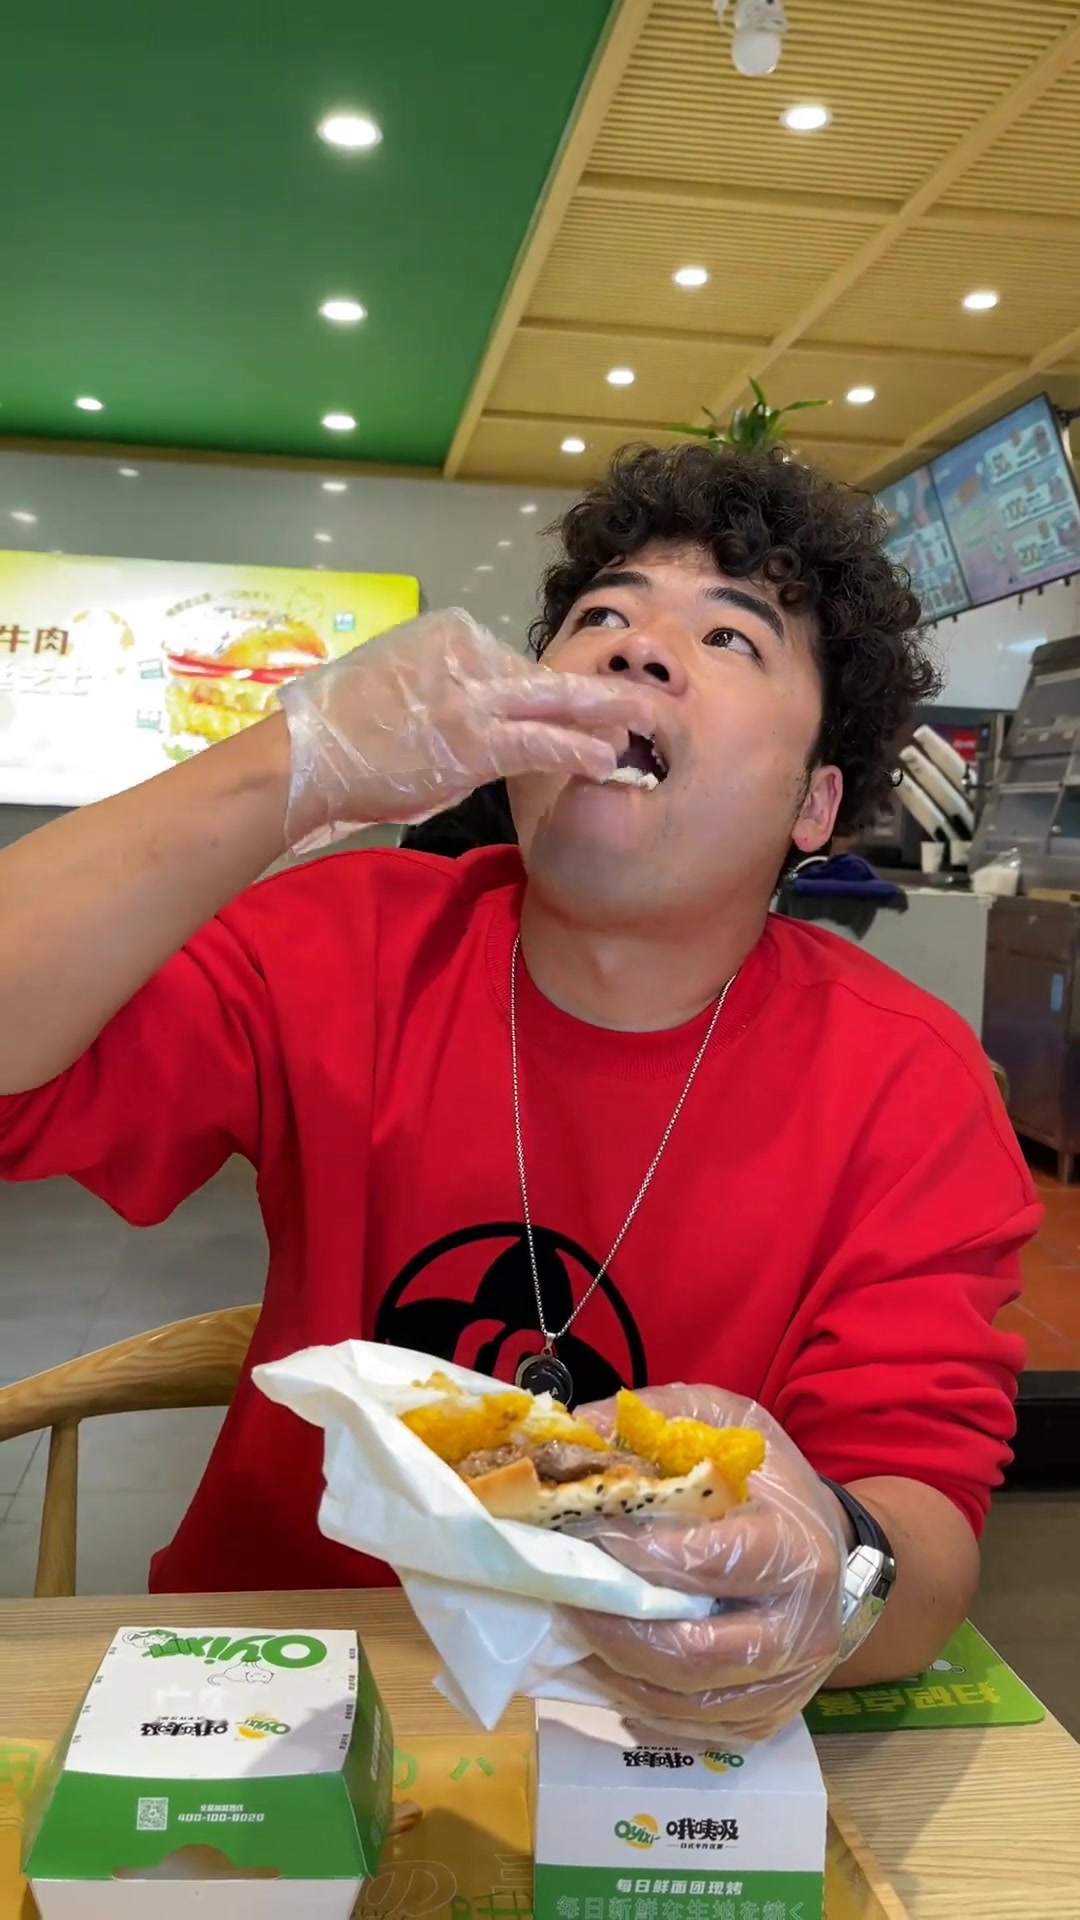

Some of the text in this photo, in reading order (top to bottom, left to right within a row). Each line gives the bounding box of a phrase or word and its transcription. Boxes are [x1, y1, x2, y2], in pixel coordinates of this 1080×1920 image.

[616, 1878, 744, 1896] 每日鲜面团现烤
